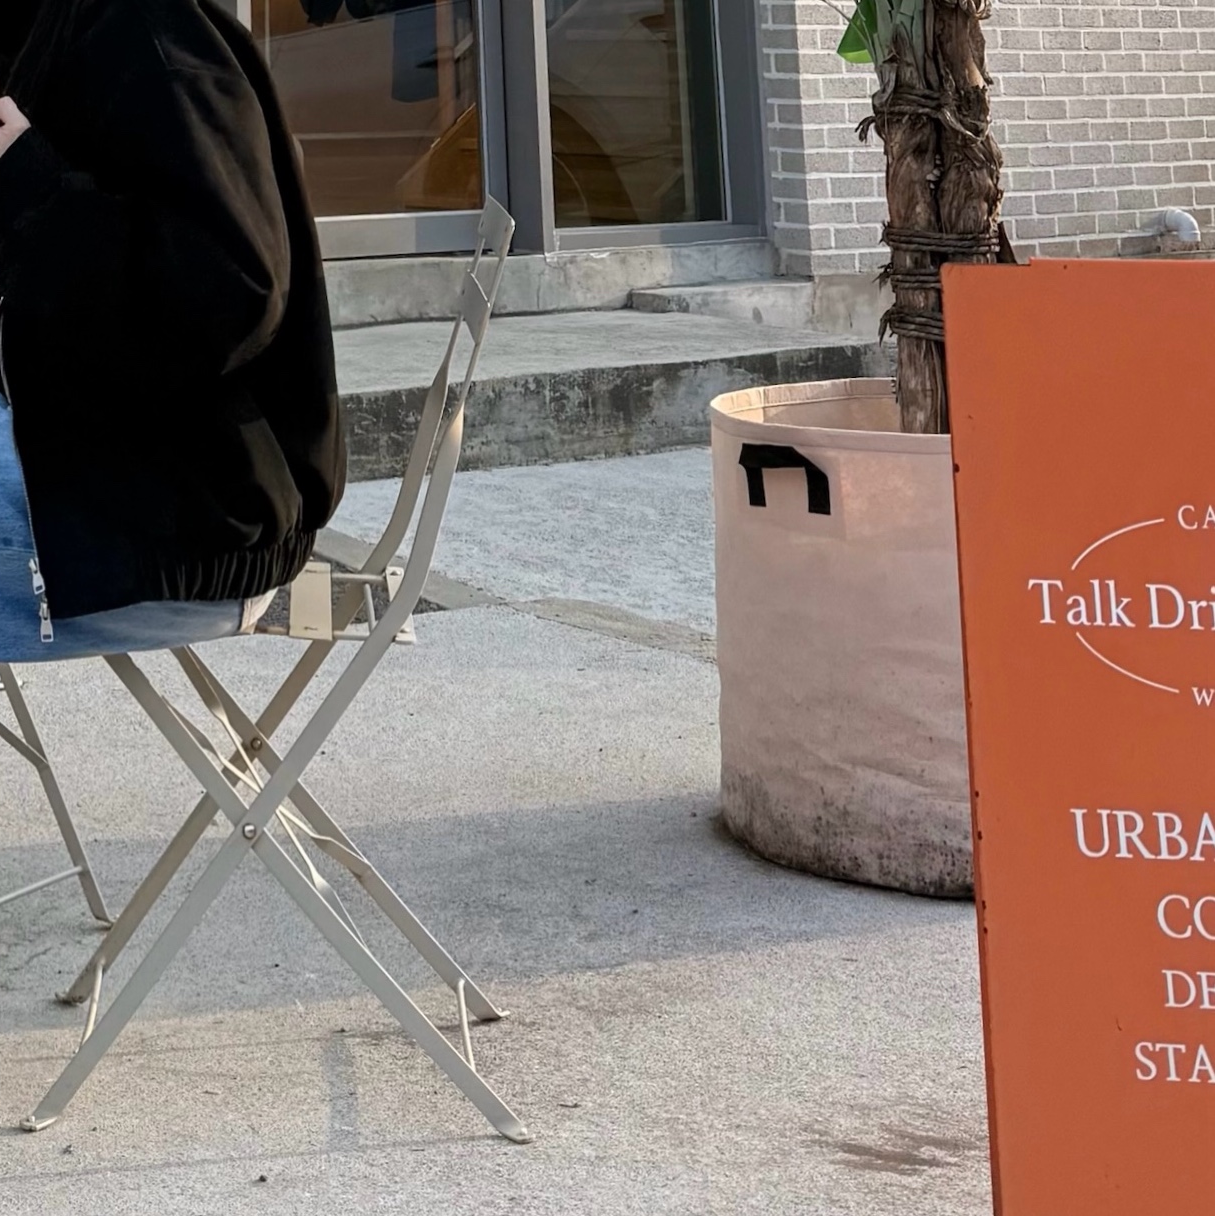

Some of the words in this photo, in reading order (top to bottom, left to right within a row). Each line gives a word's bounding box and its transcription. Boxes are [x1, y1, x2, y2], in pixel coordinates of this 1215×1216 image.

[1028, 577, 1135, 629] Talk
[1070, 807, 1215, 861] URBA
[1134, 1041, 1215, 1084] STA
